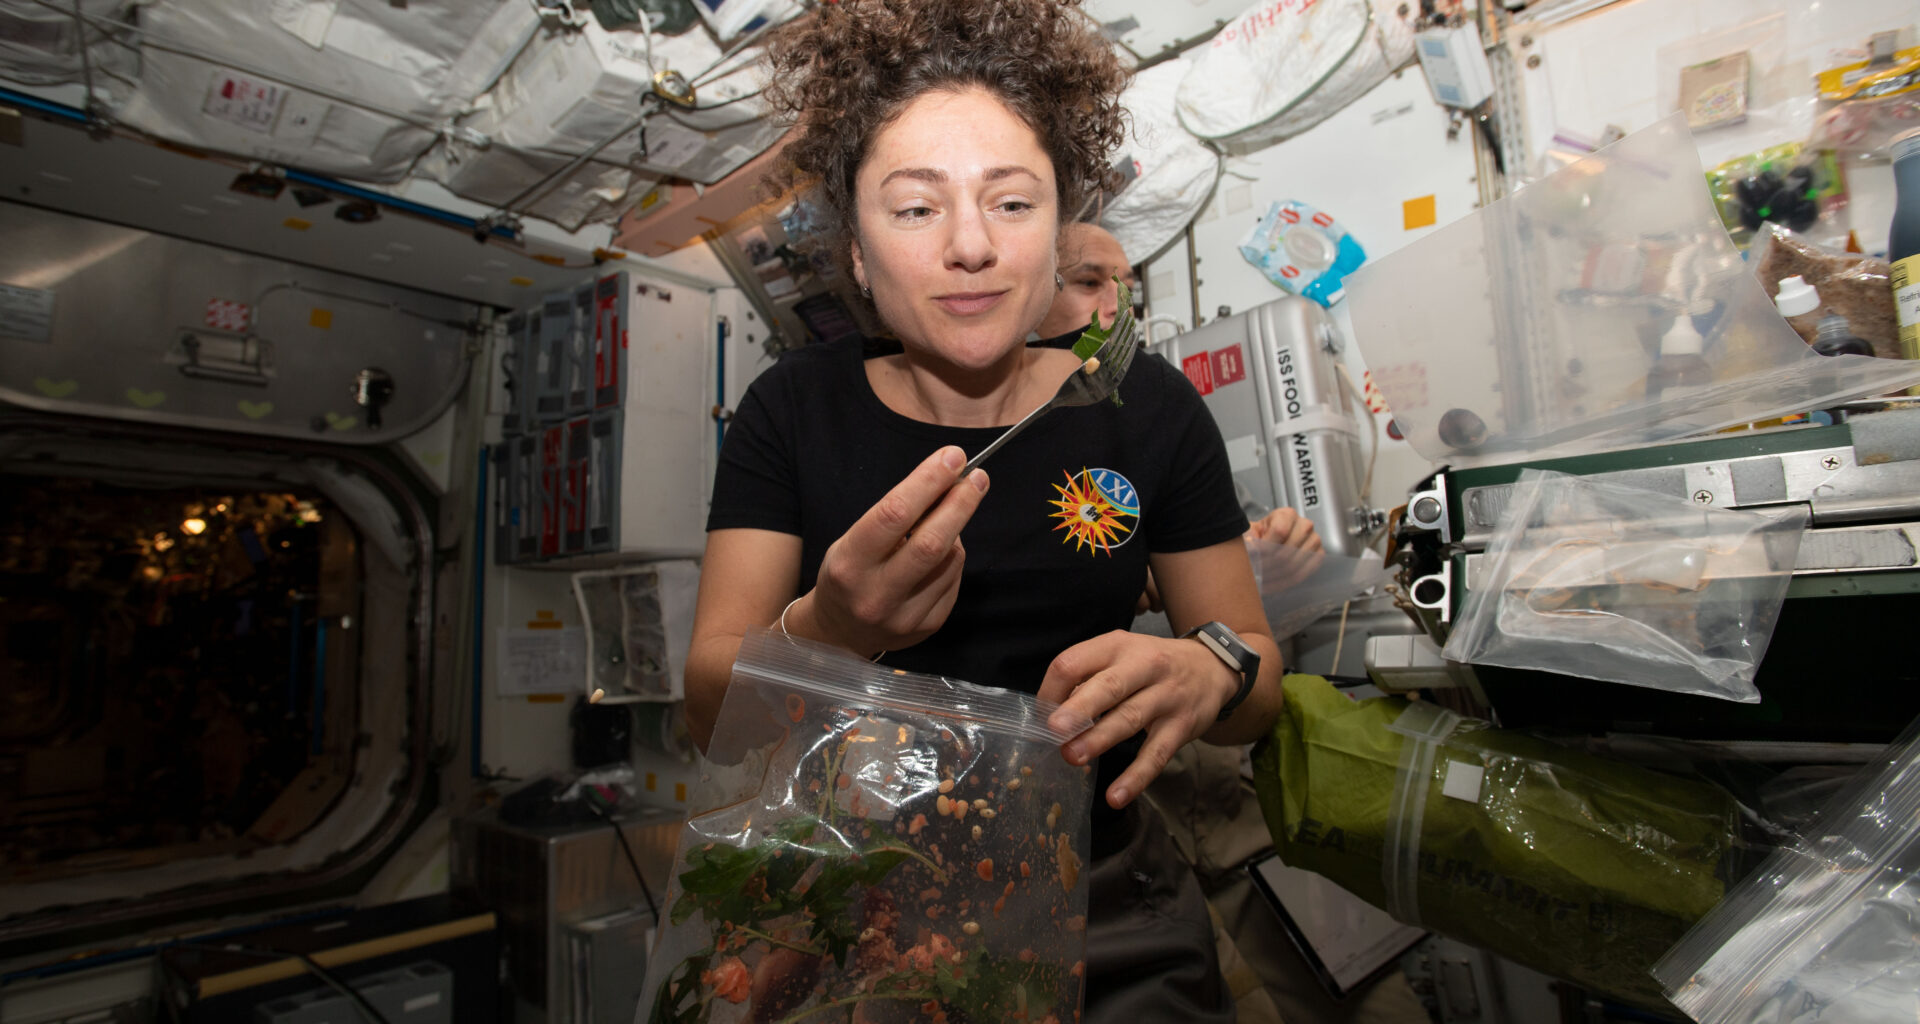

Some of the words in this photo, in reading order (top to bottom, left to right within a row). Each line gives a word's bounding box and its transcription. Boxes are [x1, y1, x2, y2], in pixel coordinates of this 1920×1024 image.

[1277, 349, 1293, 376] ISS
[1293, 432, 1319, 507] WARMER
[1096, 471, 1134, 505] LXI
[1288, 817, 1345, 853] EA
